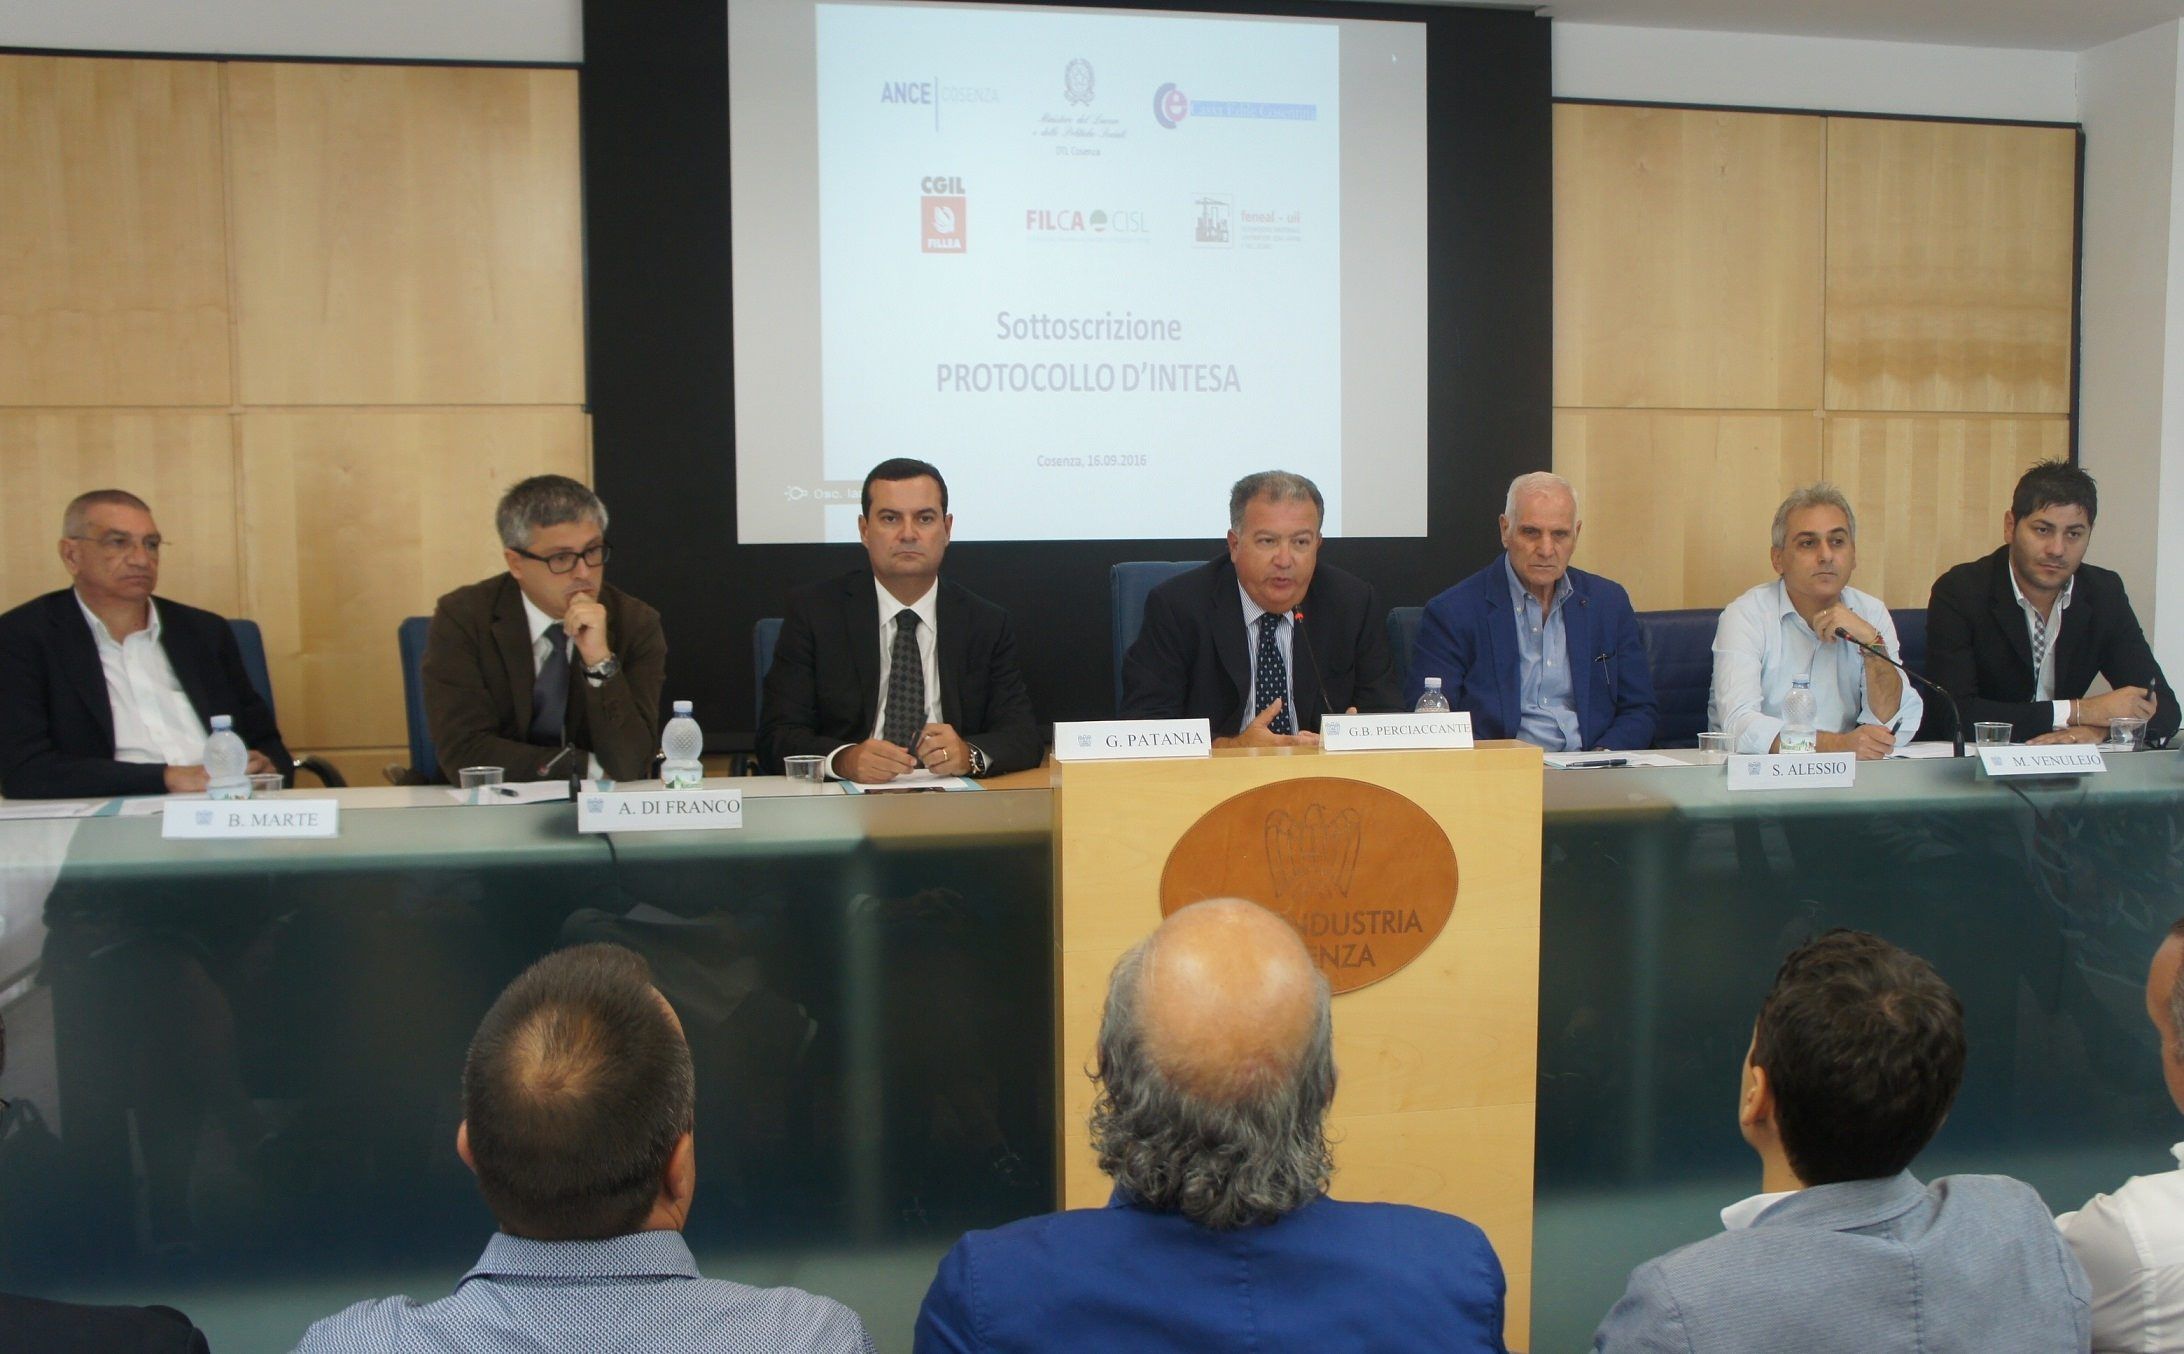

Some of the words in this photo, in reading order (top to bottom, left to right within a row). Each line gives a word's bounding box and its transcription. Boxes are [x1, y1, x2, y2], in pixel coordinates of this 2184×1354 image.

[881, 81, 931, 104] ANCE
[920, 176, 966, 194] CGIL
[1026, 209, 1085, 231] FILCA
[1112, 210, 1151, 233] CISL
[996, 311, 1183, 341] Sottoscrizione
[936, 363, 1115, 393] PROTOCOLLO
[1036, 453, 1084, 470] Cosenza,
[1087, 453, 1148, 468] 16.09.2016
[1348, 727, 1372, 737] G.B.
[1376, 723, 1470, 736] PERCIACCANTE
[1105, 734, 1122, 748] G.
[1127, 731, 1204, 748] PATANIA
[1772, 764, 1784, 777] S.
[1788, 762, 1847, 776] ALESSIO
[2012, 756, 2030, 768] M.
[618, 801, 636, 816] A.
[642, 801, 660, 815] DI
[666, 799, 741, 814] FRANCO
[228, 813, 244, 828] B.
[250, 812, 320, 827] MARTE
[1283, 909, 1424, 937] NDUSTRIA
[1307, 943, 1377, 969] ENZA
